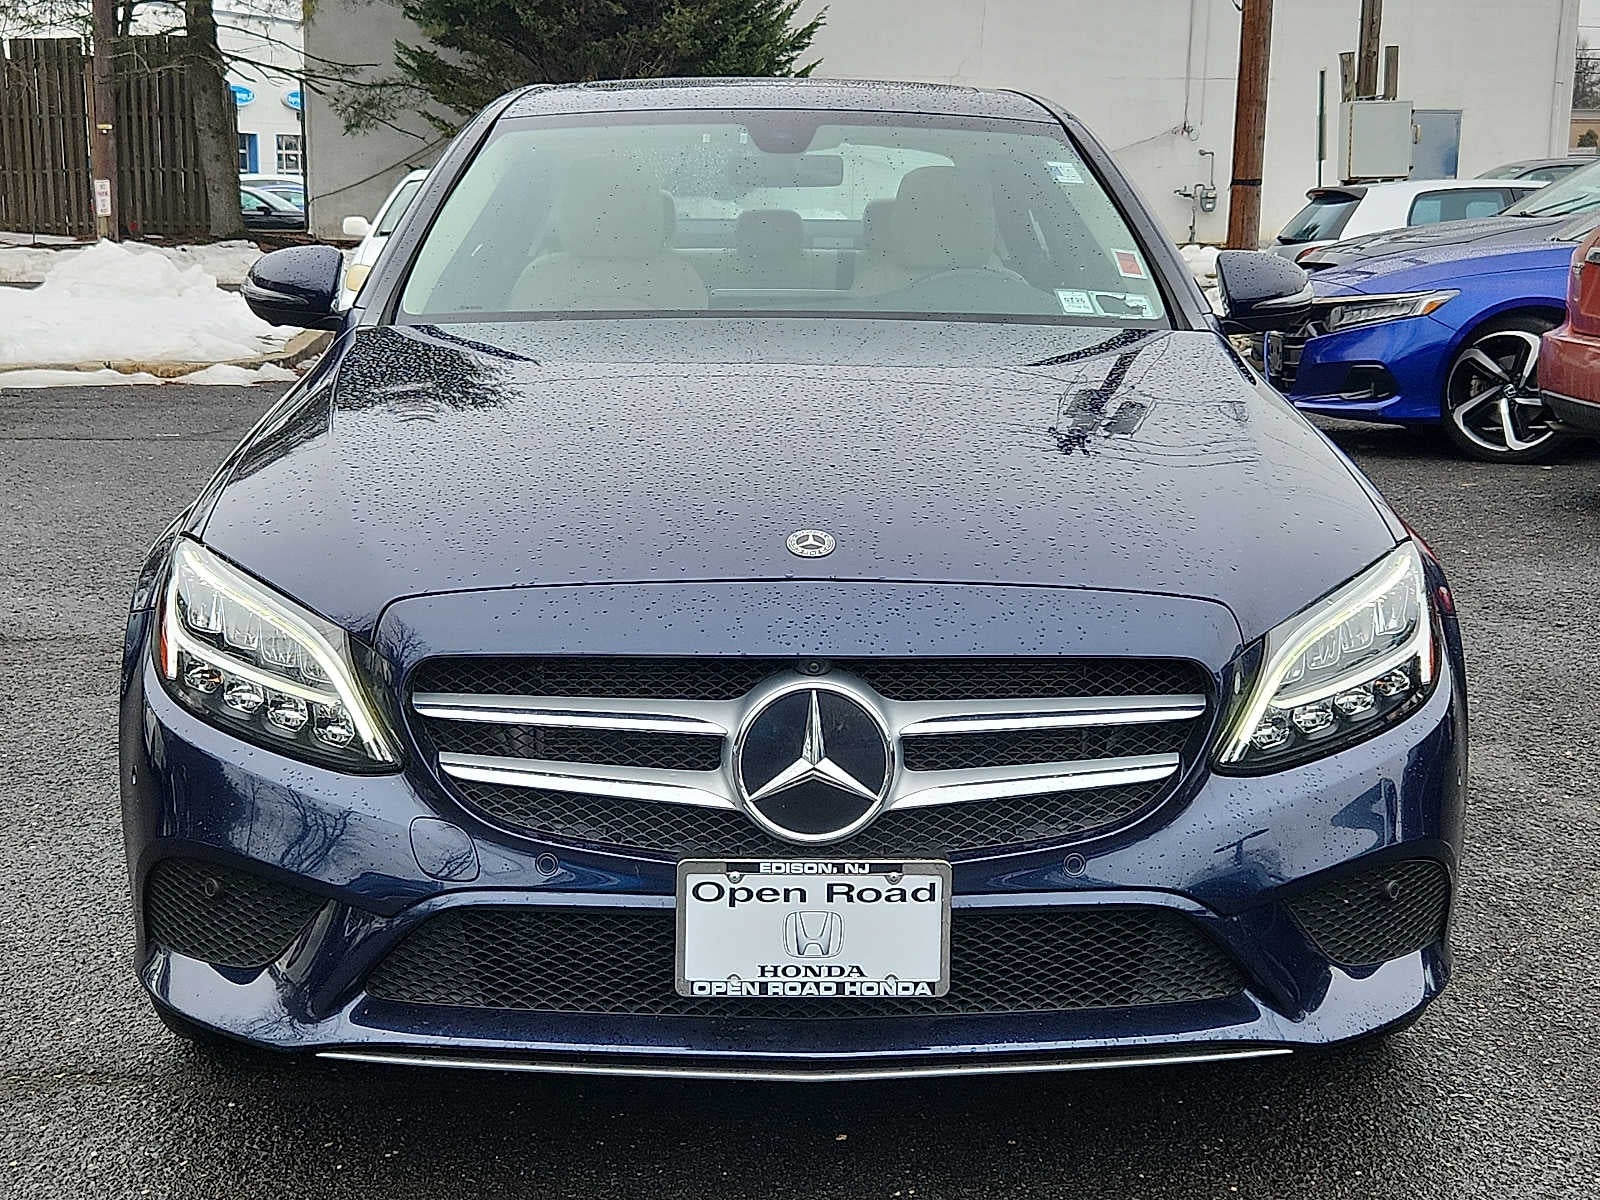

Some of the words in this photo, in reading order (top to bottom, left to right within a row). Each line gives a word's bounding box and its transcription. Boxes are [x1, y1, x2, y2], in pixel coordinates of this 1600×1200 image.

[759, 862, 838, 875] EDISON,
[845, 862, 870, 874] NJ
[692, 881, 807, 908] Open
[826, 882, 936, 904] Road
[757, 964, 867, 978] HONDA
[692, 981, 760, 996] OPEN
[768, 981, 840, 996] ROAD
[844, 981, 933, 996] HONDA
